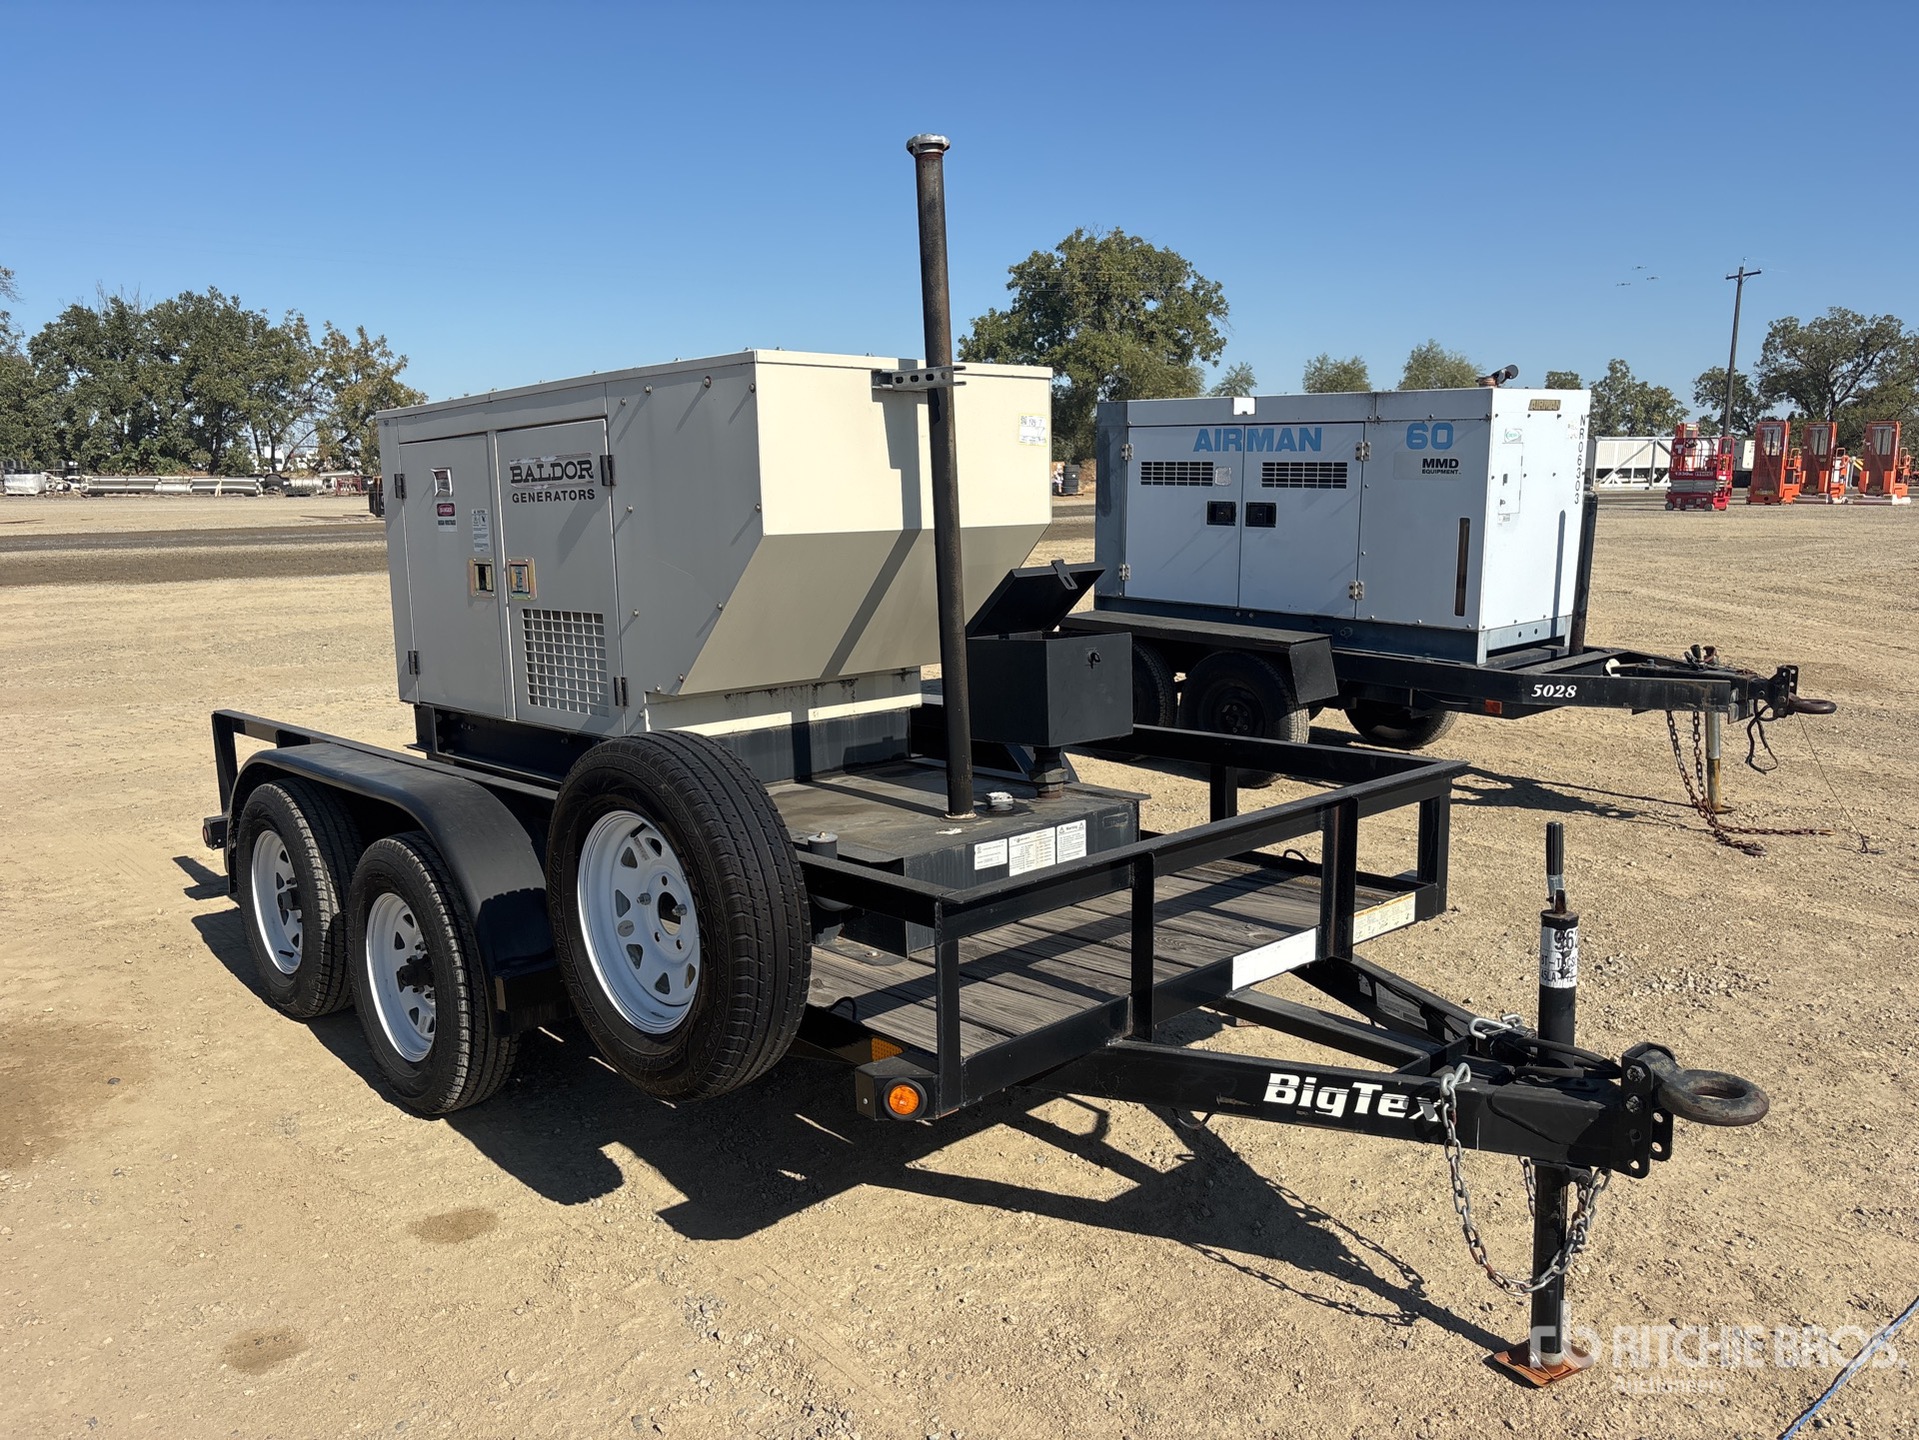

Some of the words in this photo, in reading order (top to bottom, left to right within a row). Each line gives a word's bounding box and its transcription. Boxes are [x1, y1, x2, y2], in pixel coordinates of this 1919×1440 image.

[1530, 400, 1560, 409] AIRMAN
[1193, 427, 1322, 452] AIRMAN
[1406, 422, 1454, 450] 60
[510, 459, 594, 484] BALDOR
[1422, 458, 1459, 469] MMD
[512, 488, 595, 503] GENERATORS
[1531, 684, 1577, 698] 5028
[1263, 1072, 1442, 1123] BigTex
